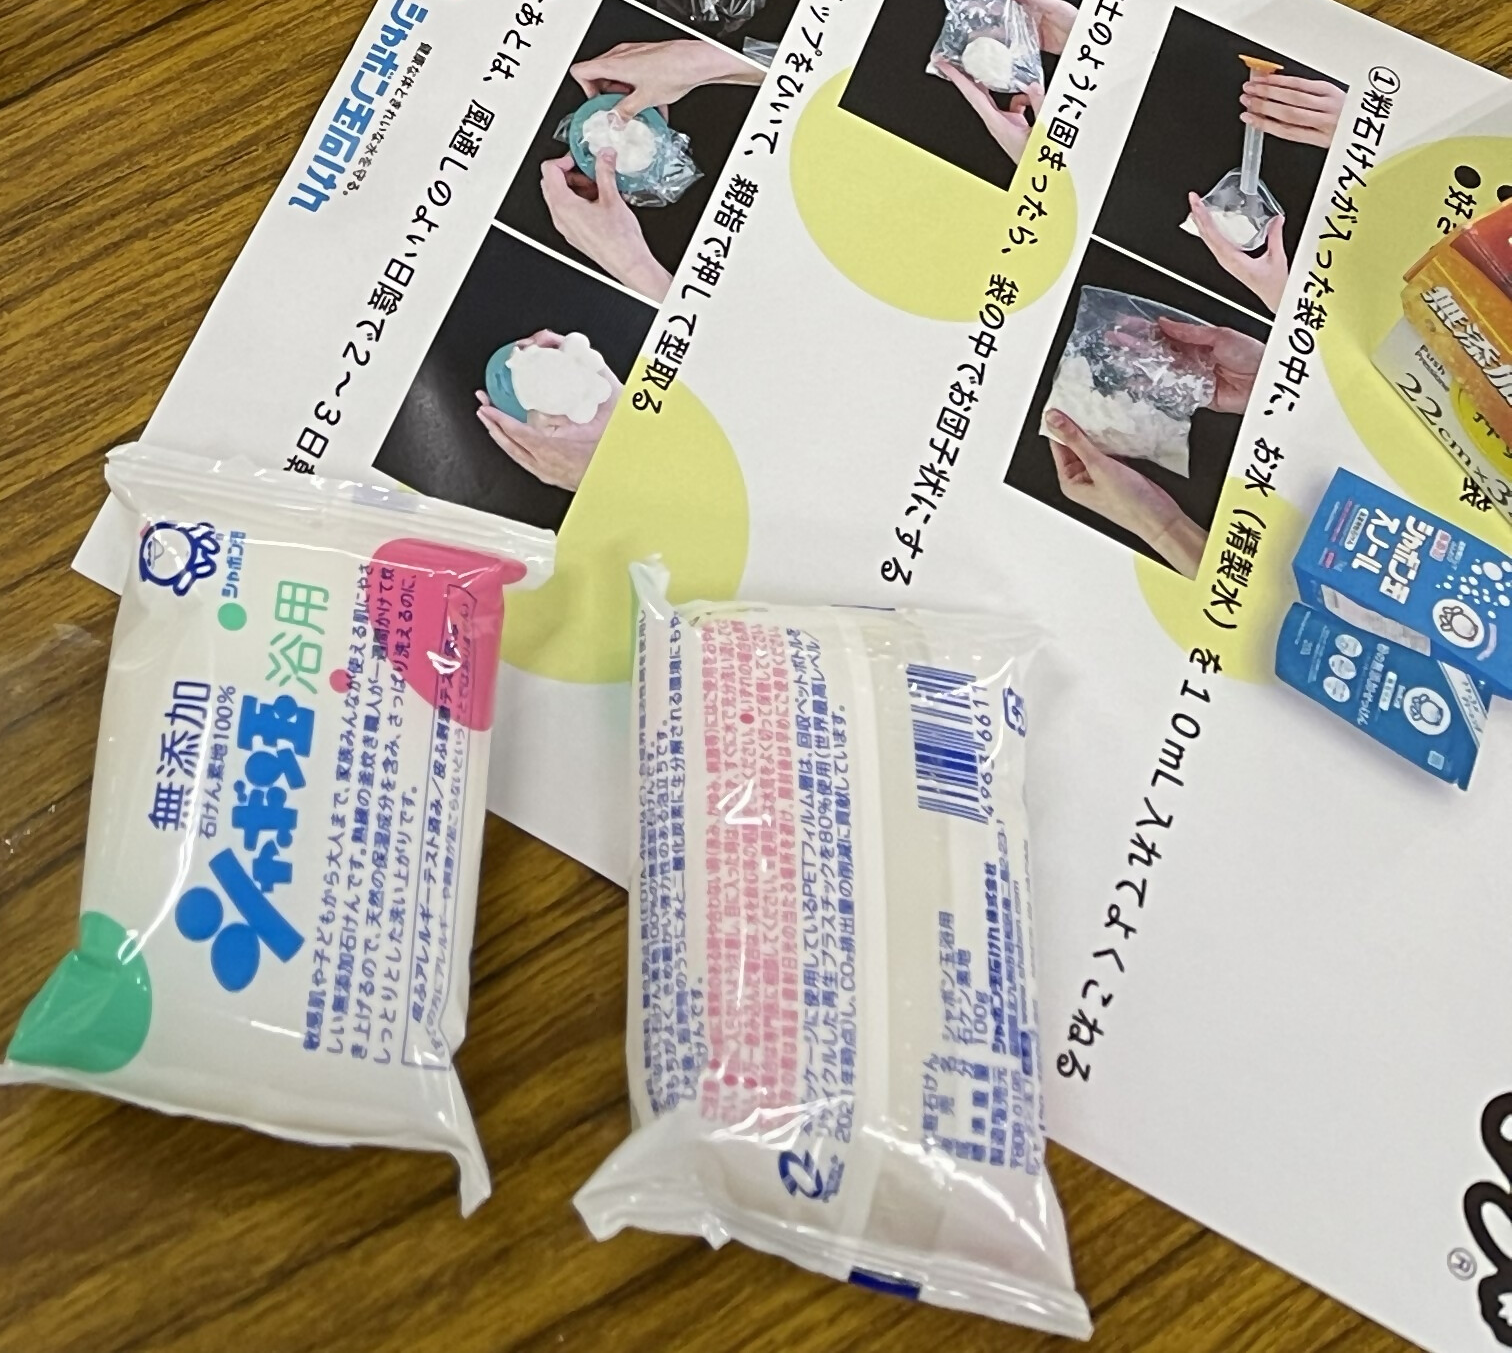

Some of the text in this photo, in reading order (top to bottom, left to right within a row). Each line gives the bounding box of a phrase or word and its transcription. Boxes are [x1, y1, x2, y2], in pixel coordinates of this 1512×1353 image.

[340, 40, 433, 199] 健康な体ときれいな水を守る。
[1419, 344, 1446, 375] Push
[1350, 507, 1401, 574] スノール
[1377, 514, 1435, 604] シャボン玉
[265, 580, 330, 693] 浴用
[148, 678, 212, 833] 無添加
[175, 695, 316, 991] シャボン玉
[373, 785, 419, 1064] しっとりとした洗い上がりです。
[938, 911, 956, 1040] シャボン玉浴用
[973, 990, 988, 1045] 100g
